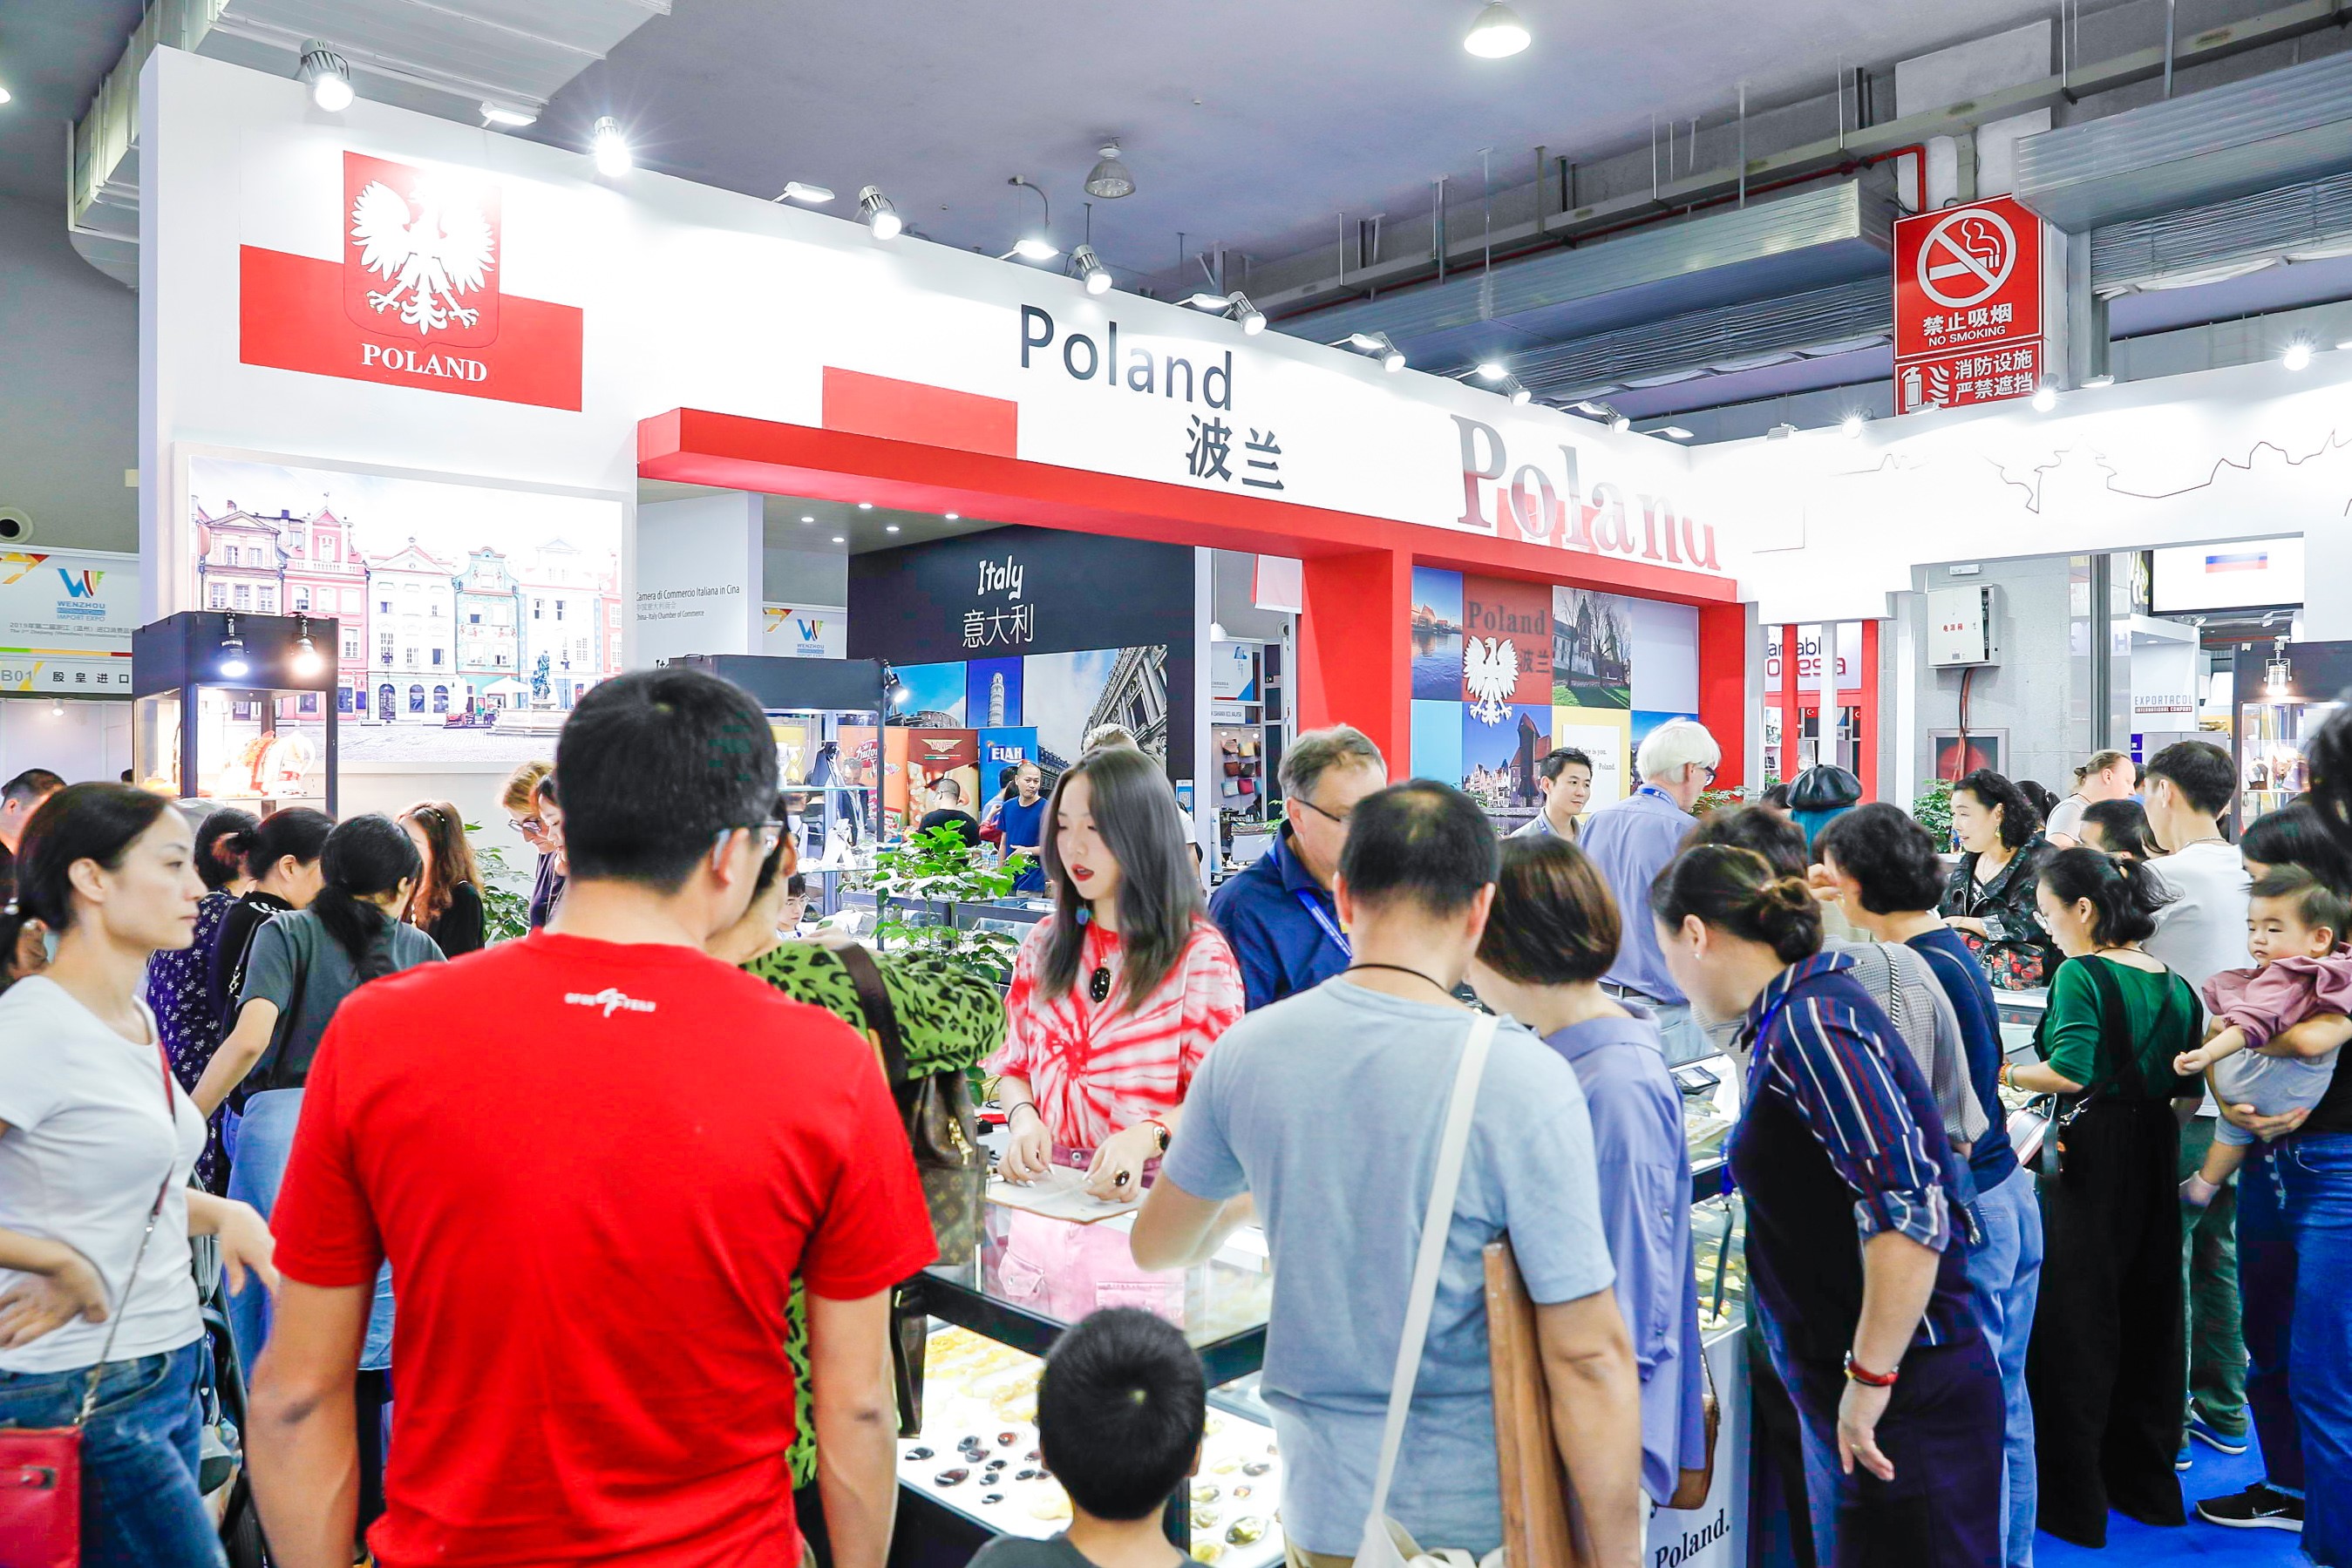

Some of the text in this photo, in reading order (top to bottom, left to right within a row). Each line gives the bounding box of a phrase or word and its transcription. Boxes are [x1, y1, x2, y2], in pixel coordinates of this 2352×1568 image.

[1922, 302, 2013, 336] 禁止吸烟
[1928, 325, 2006, 347] NO SMOKING
[361, 343, 488, 382] POLAND
[1021, 303, 1233, 411] Poland
[1954, 349, 2033, 380] 消防设施
[1954, 371, 2033, 403] 严禁遮挡
[1186, 413, 1284, 490] 波兰
[663, 587, 695, 599] Commercio
[696, 587, 718, 597] Italiana
[719, 586, 725, 595] in
[726, 584, 740, 594] Cina
[977, 554, 1023, 601] Italy
[57, 601, 105, 609] WENZHOU
[1467, 600, 1546, 635] Poland
[962, 603, 1034, 648] 意大利
[2134, 695, 2192, 705] EXPORTACOL
[1655, 1507, 1730, 1568] Poland.
